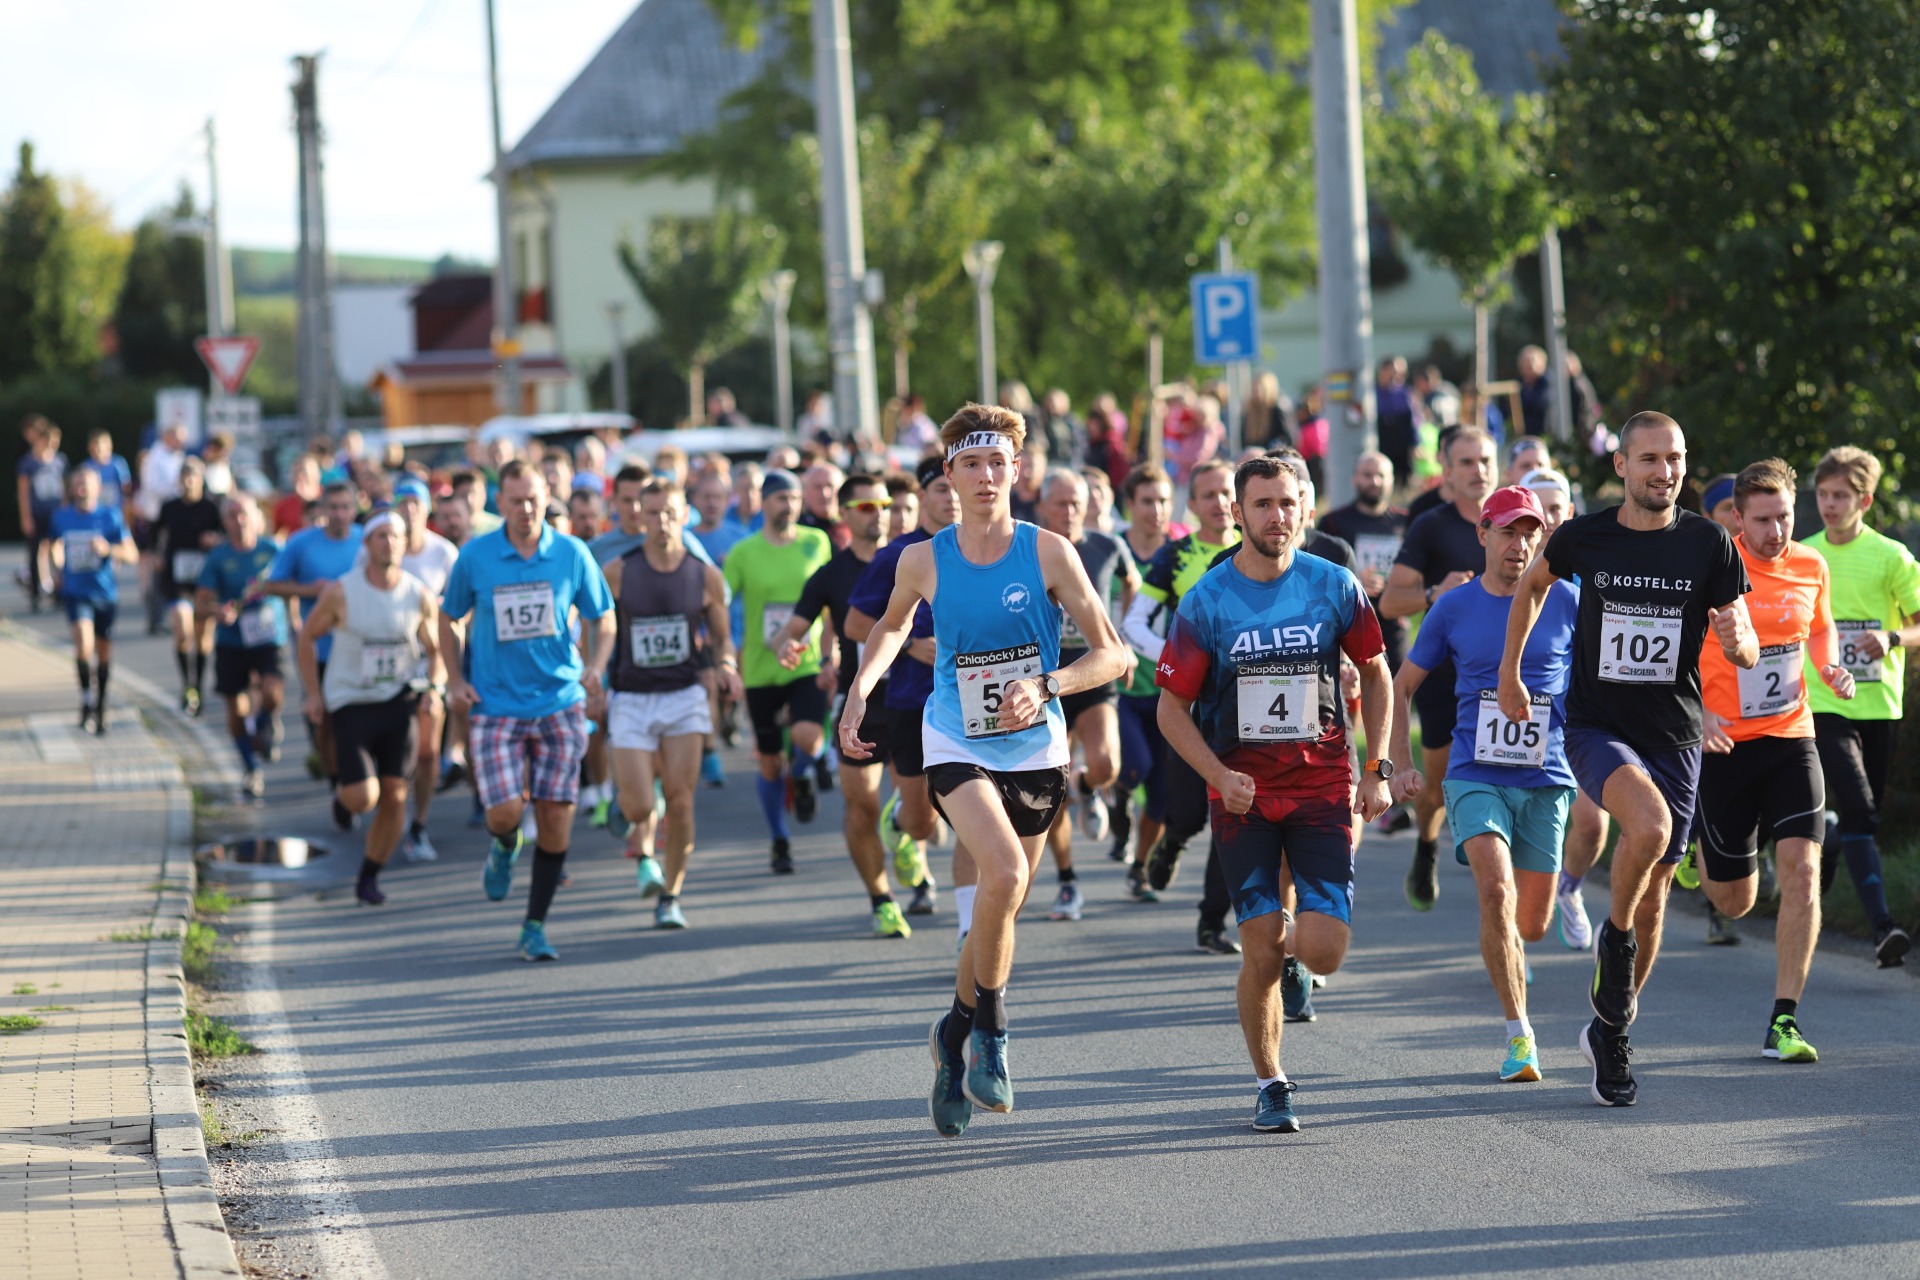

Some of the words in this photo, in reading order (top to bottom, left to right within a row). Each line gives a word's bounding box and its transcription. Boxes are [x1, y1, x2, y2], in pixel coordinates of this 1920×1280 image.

[1205, 285, 1245, 339] P
[1613, 575, 1692, 591] KOSTEL.CZ
[503, 604, 546, 626] 157
[1604, 601, 1660, 617] Chlapácký
[1662, 606, 1682, 617] běh
[640, 634, 682, 655] 194
[1229, 622, 1323, 654] ALISY
[1610, 632, 1671, 663] 102
[957, 649, 1016, 666] Chlapácký
[1018, 645, 1038, 657] běh
[1229, 651, 1271, 662] SPORT
[1274, 648, 1310, 657] TEAM
[1239, 664, 1295, 675] Chlapácký
[1297, 662, 1317, 673] běh
[1765, 672, 1781, 698] 2
[983, 679, 1017, 714] 5
[1268, 693, 1289, 722] 4
[1533, 694, 1551, 705] běh
[1486, 718, 1540, 748] 105
